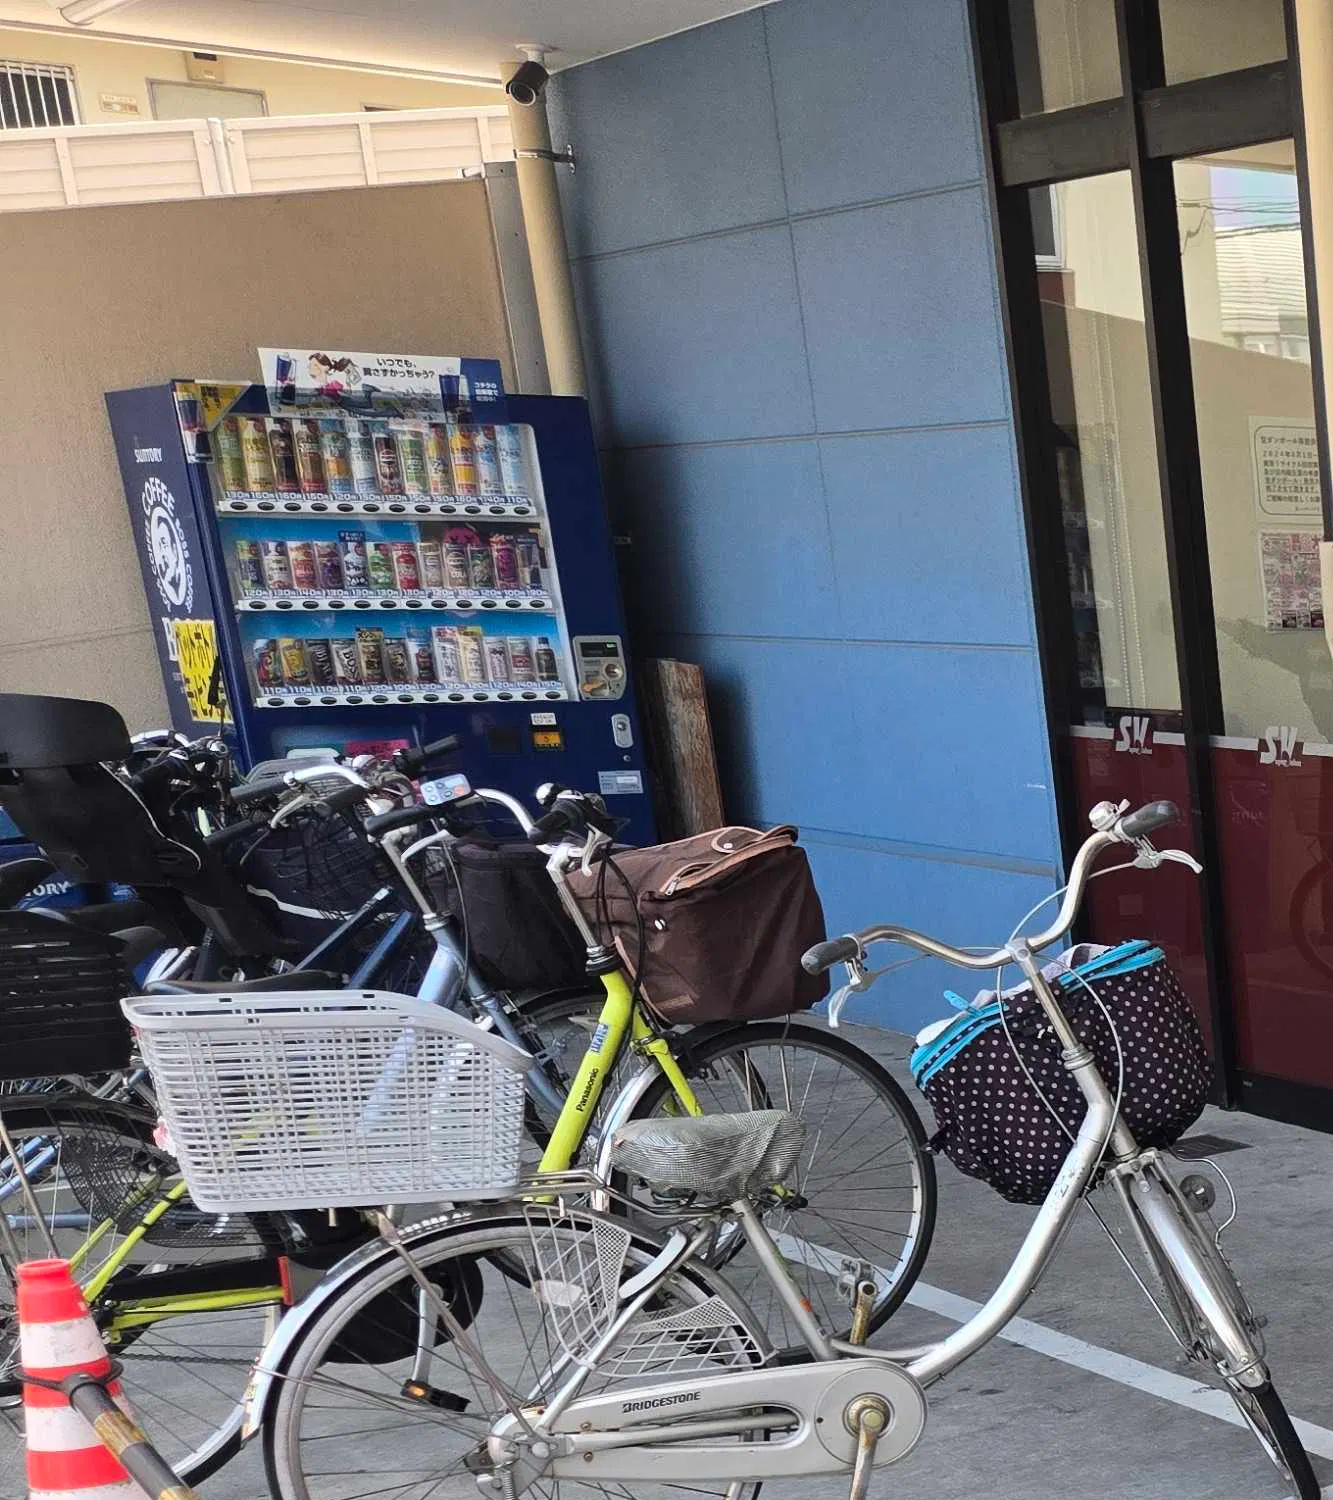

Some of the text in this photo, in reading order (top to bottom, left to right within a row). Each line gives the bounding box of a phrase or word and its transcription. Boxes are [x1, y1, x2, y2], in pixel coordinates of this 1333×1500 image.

[134, 448, 162, 463] SUNTORY
[576, 1067, 599, 1112] Panasonic
[622, 1392, 701, 1413] BRIDGESTONE
